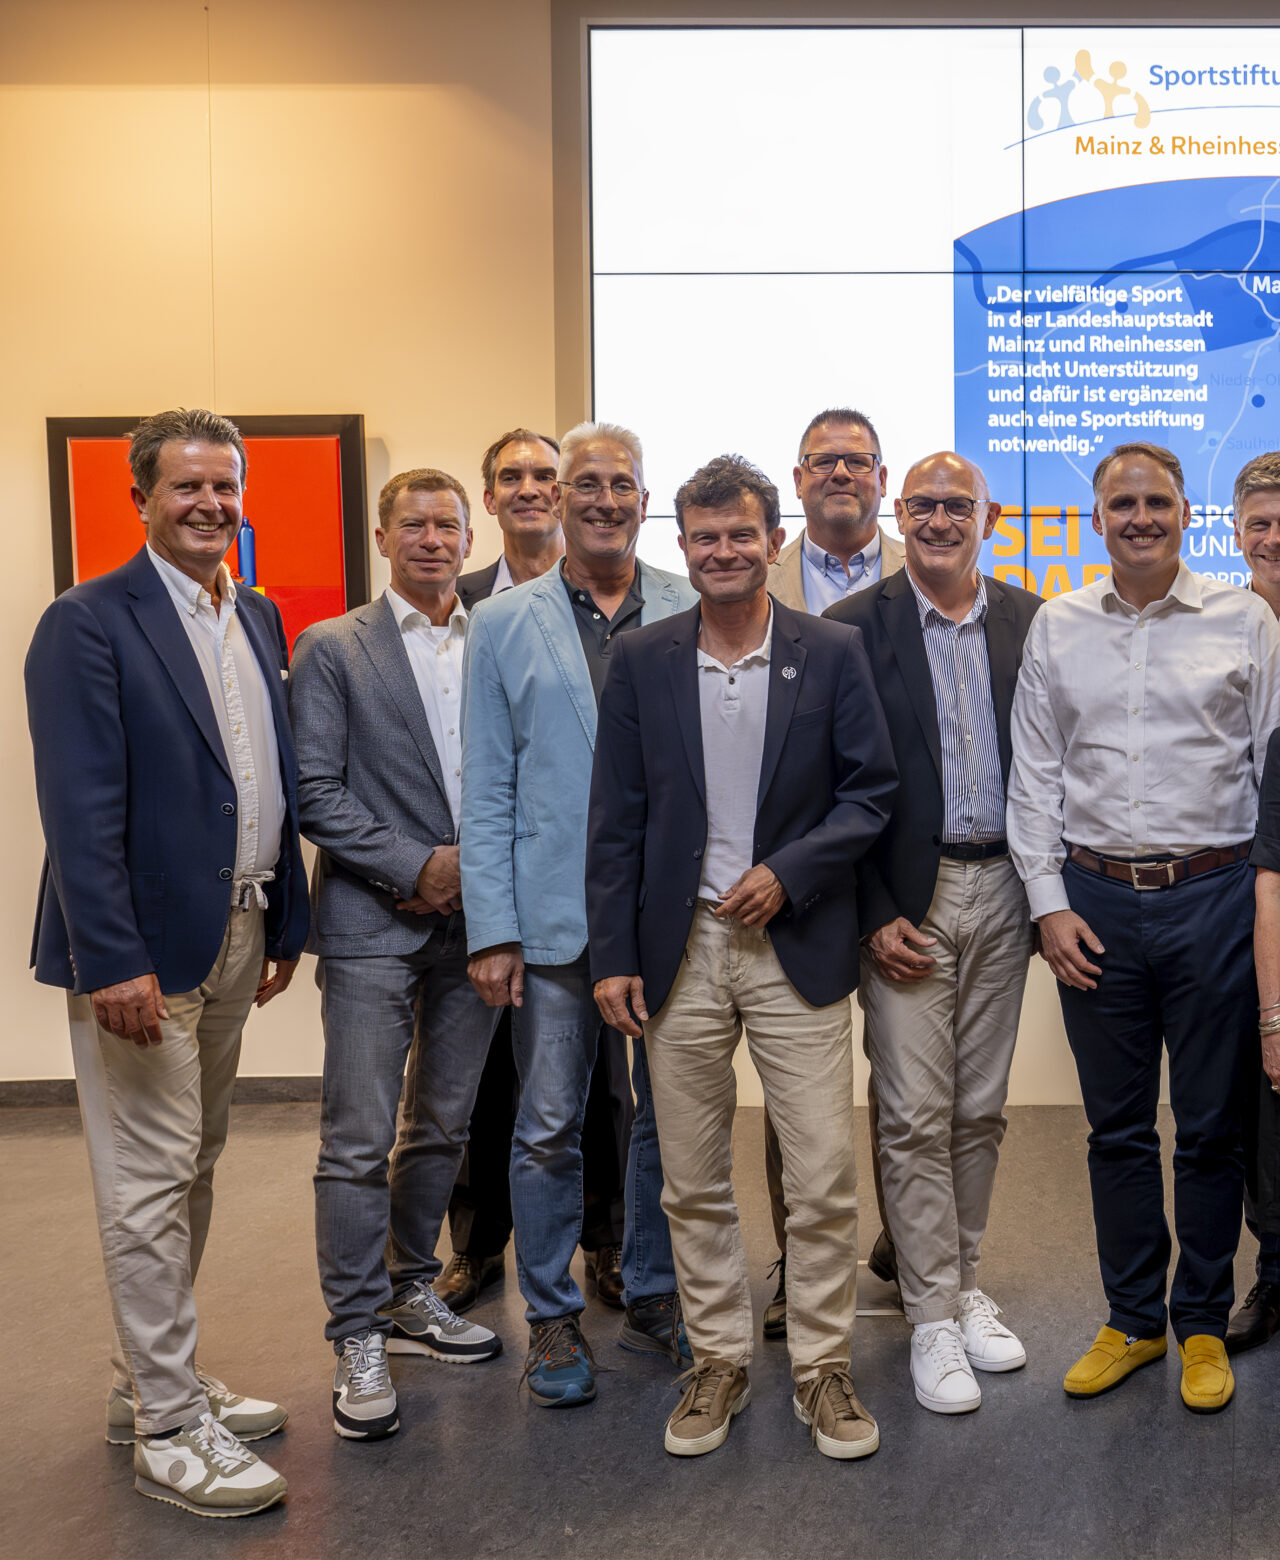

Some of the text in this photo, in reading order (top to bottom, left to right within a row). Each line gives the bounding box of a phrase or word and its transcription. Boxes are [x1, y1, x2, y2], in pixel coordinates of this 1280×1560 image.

[1075, 136, 1143, 155] Mainz
[1149, 136, 1165, 155] &
[987, 285, 1183, 307] „Der vielfältige Sport
[987, 310, 1214, 331] in der Landeshauptstadt
[987, 335, 1206, 352] Mainz und Rheinhessen
[988, 360, 1199, 381] braucht Unterstützung
[988, 385, 1208, 406] und dafür ist ergänzend
[988, 410, 1205, 431] auch eine Sportstiftung
[988, 435, 1104, 456] notwendig.“
[1189, 505, 1234, 528] SPO
[992, 505, 1080, 557] SEI
